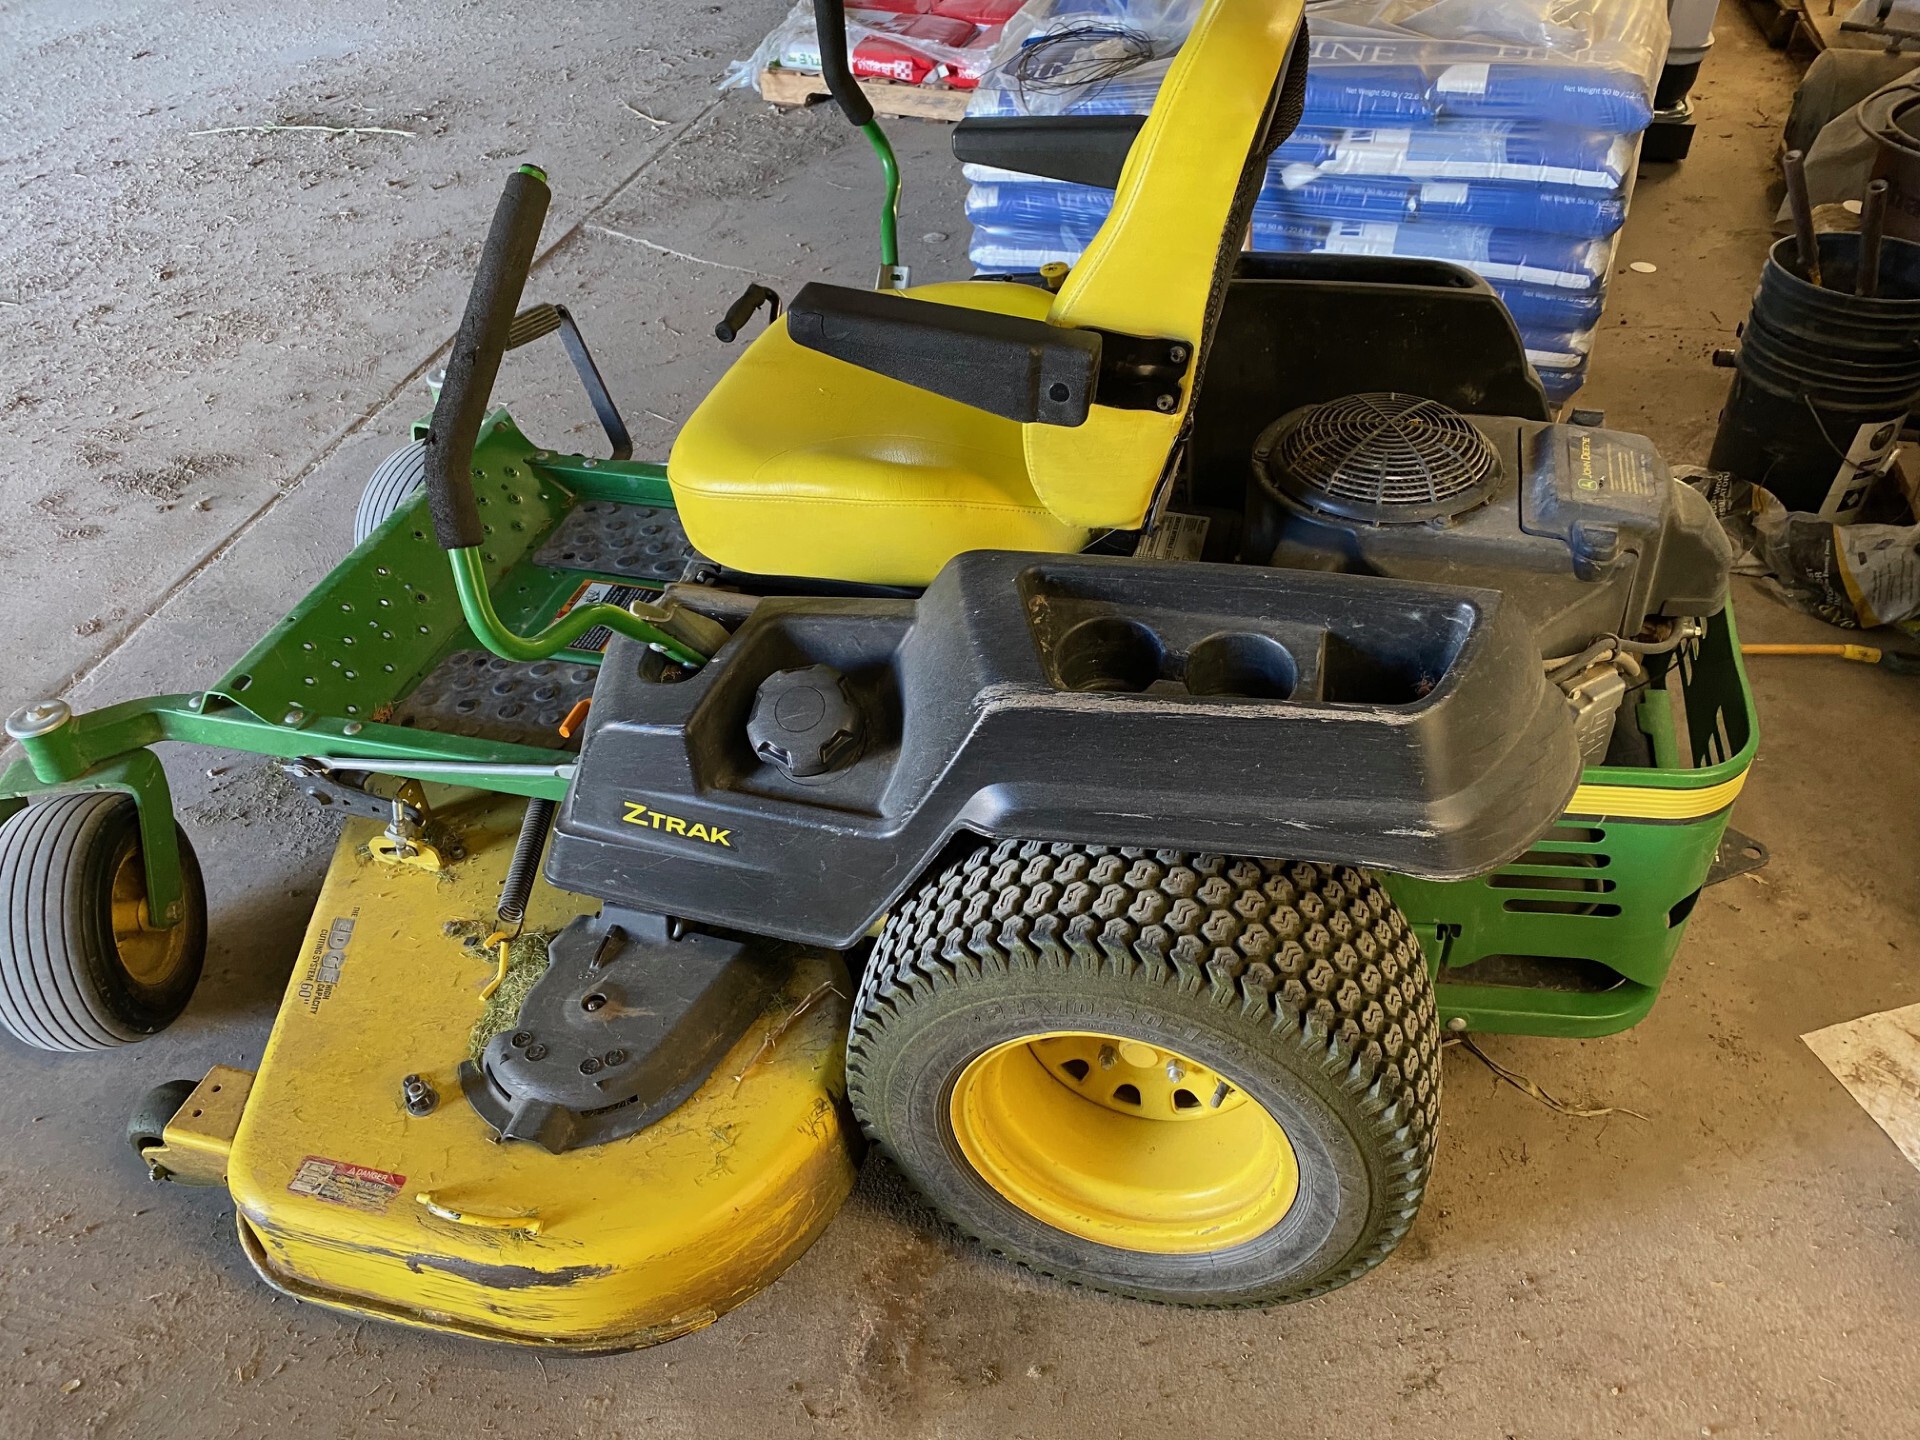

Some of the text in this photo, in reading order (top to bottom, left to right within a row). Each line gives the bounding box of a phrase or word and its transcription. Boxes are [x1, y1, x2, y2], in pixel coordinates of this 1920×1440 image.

[1310, 42, 1396, 62] INE
[1345, 86, 1357, 95] Net
[1358, 87, 1380, 98] Weight
[1381, 89, 1391, 98] 50
[1563, 84, 1576, 93] Net
[1577, 85, 1600, 96] Weight
[1602, 87, 1612, 96] 50
[1613, 88, 1620, 97] lb
[1581, 436, 1593, 479] JOHN DEERE
[622, 801, 732, 847] ZTRAK
[351, 906, 360, 917] THE
[314, 928, 328, 955] CUTTING
[316, 916, 355, 985] EDGE
[306, 955, 320, 981] SYSTEM
[310, 983, 325, 1015] CAPACITY
[323, 984, 333, 1000] HIGH
[355, 1168, 389, 1181] DANGER
